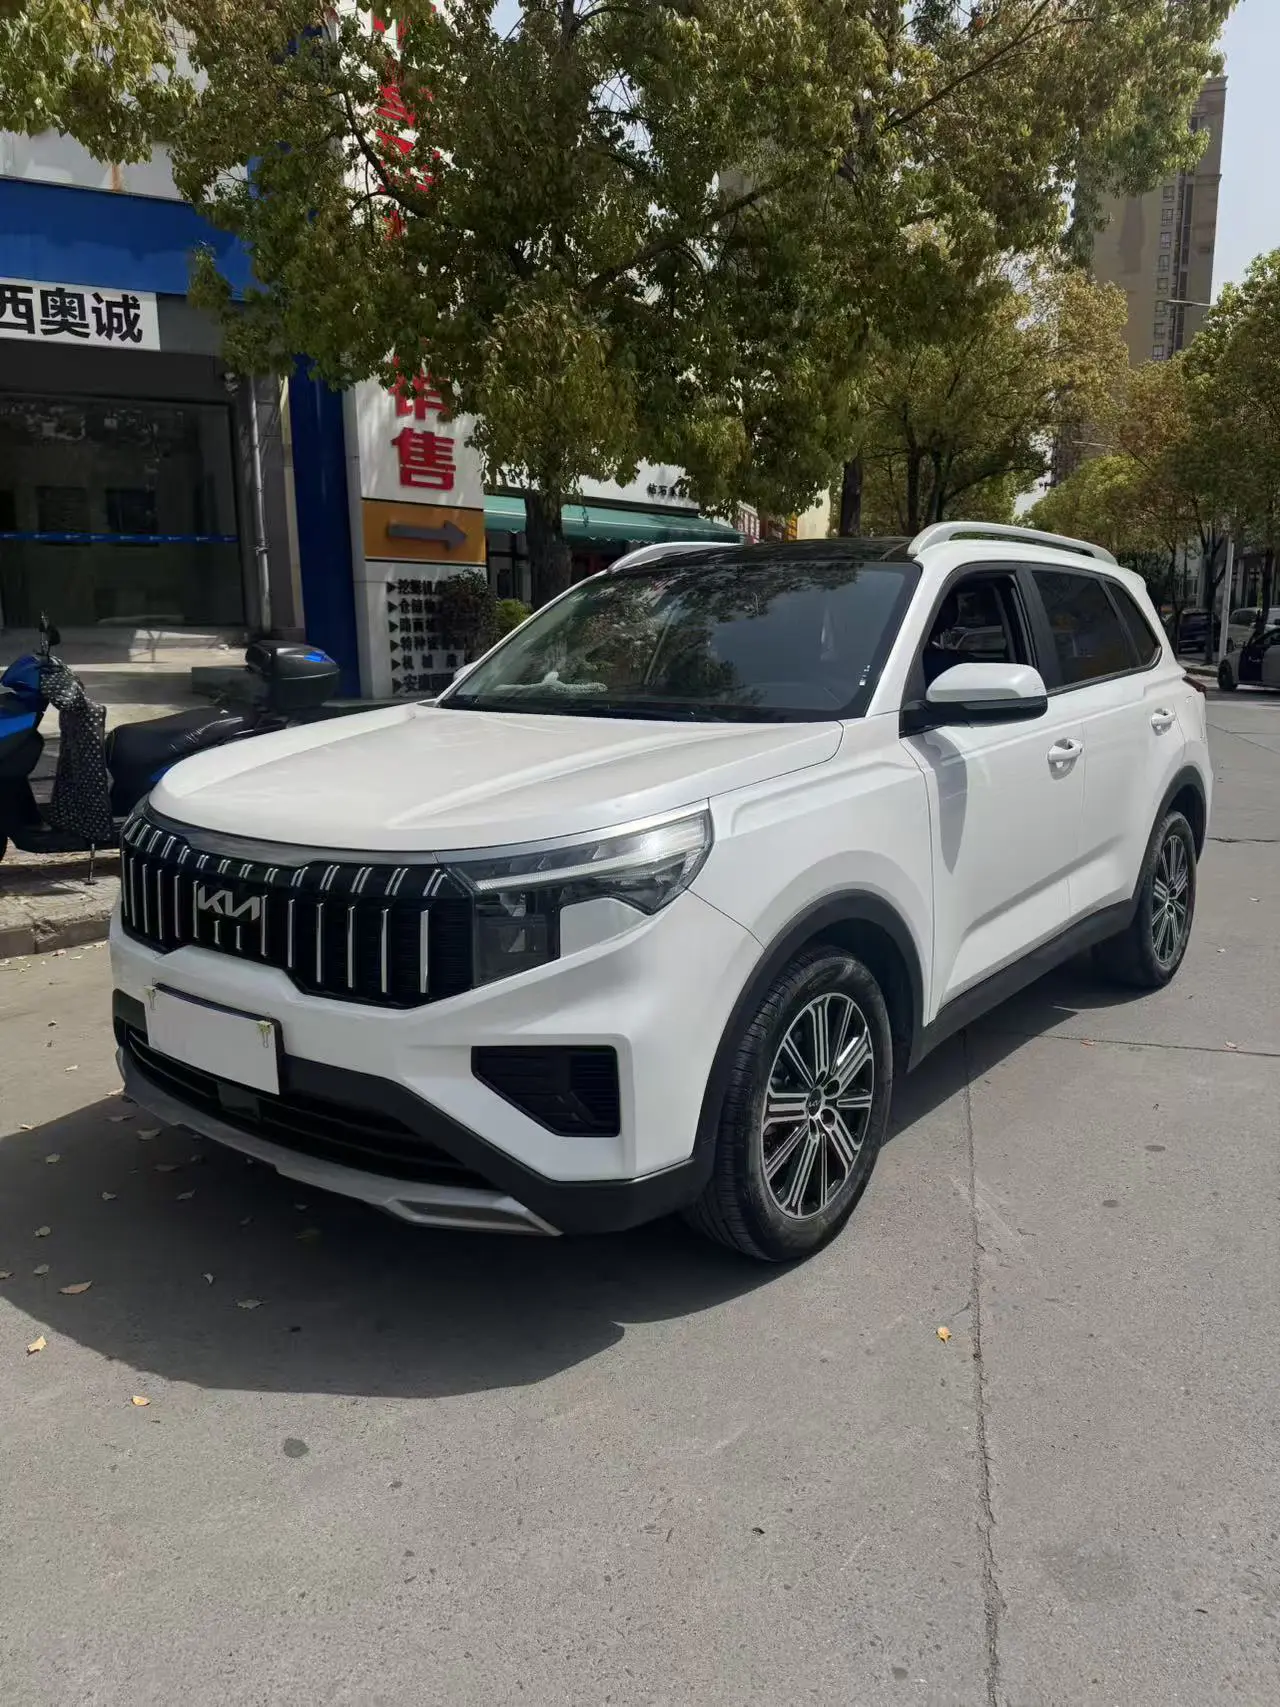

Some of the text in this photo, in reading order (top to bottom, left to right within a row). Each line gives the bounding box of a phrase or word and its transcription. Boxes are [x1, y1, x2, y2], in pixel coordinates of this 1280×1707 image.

[0, 283, 143, 344] 西奥诚
[197, 885, 262, 921] KIA
